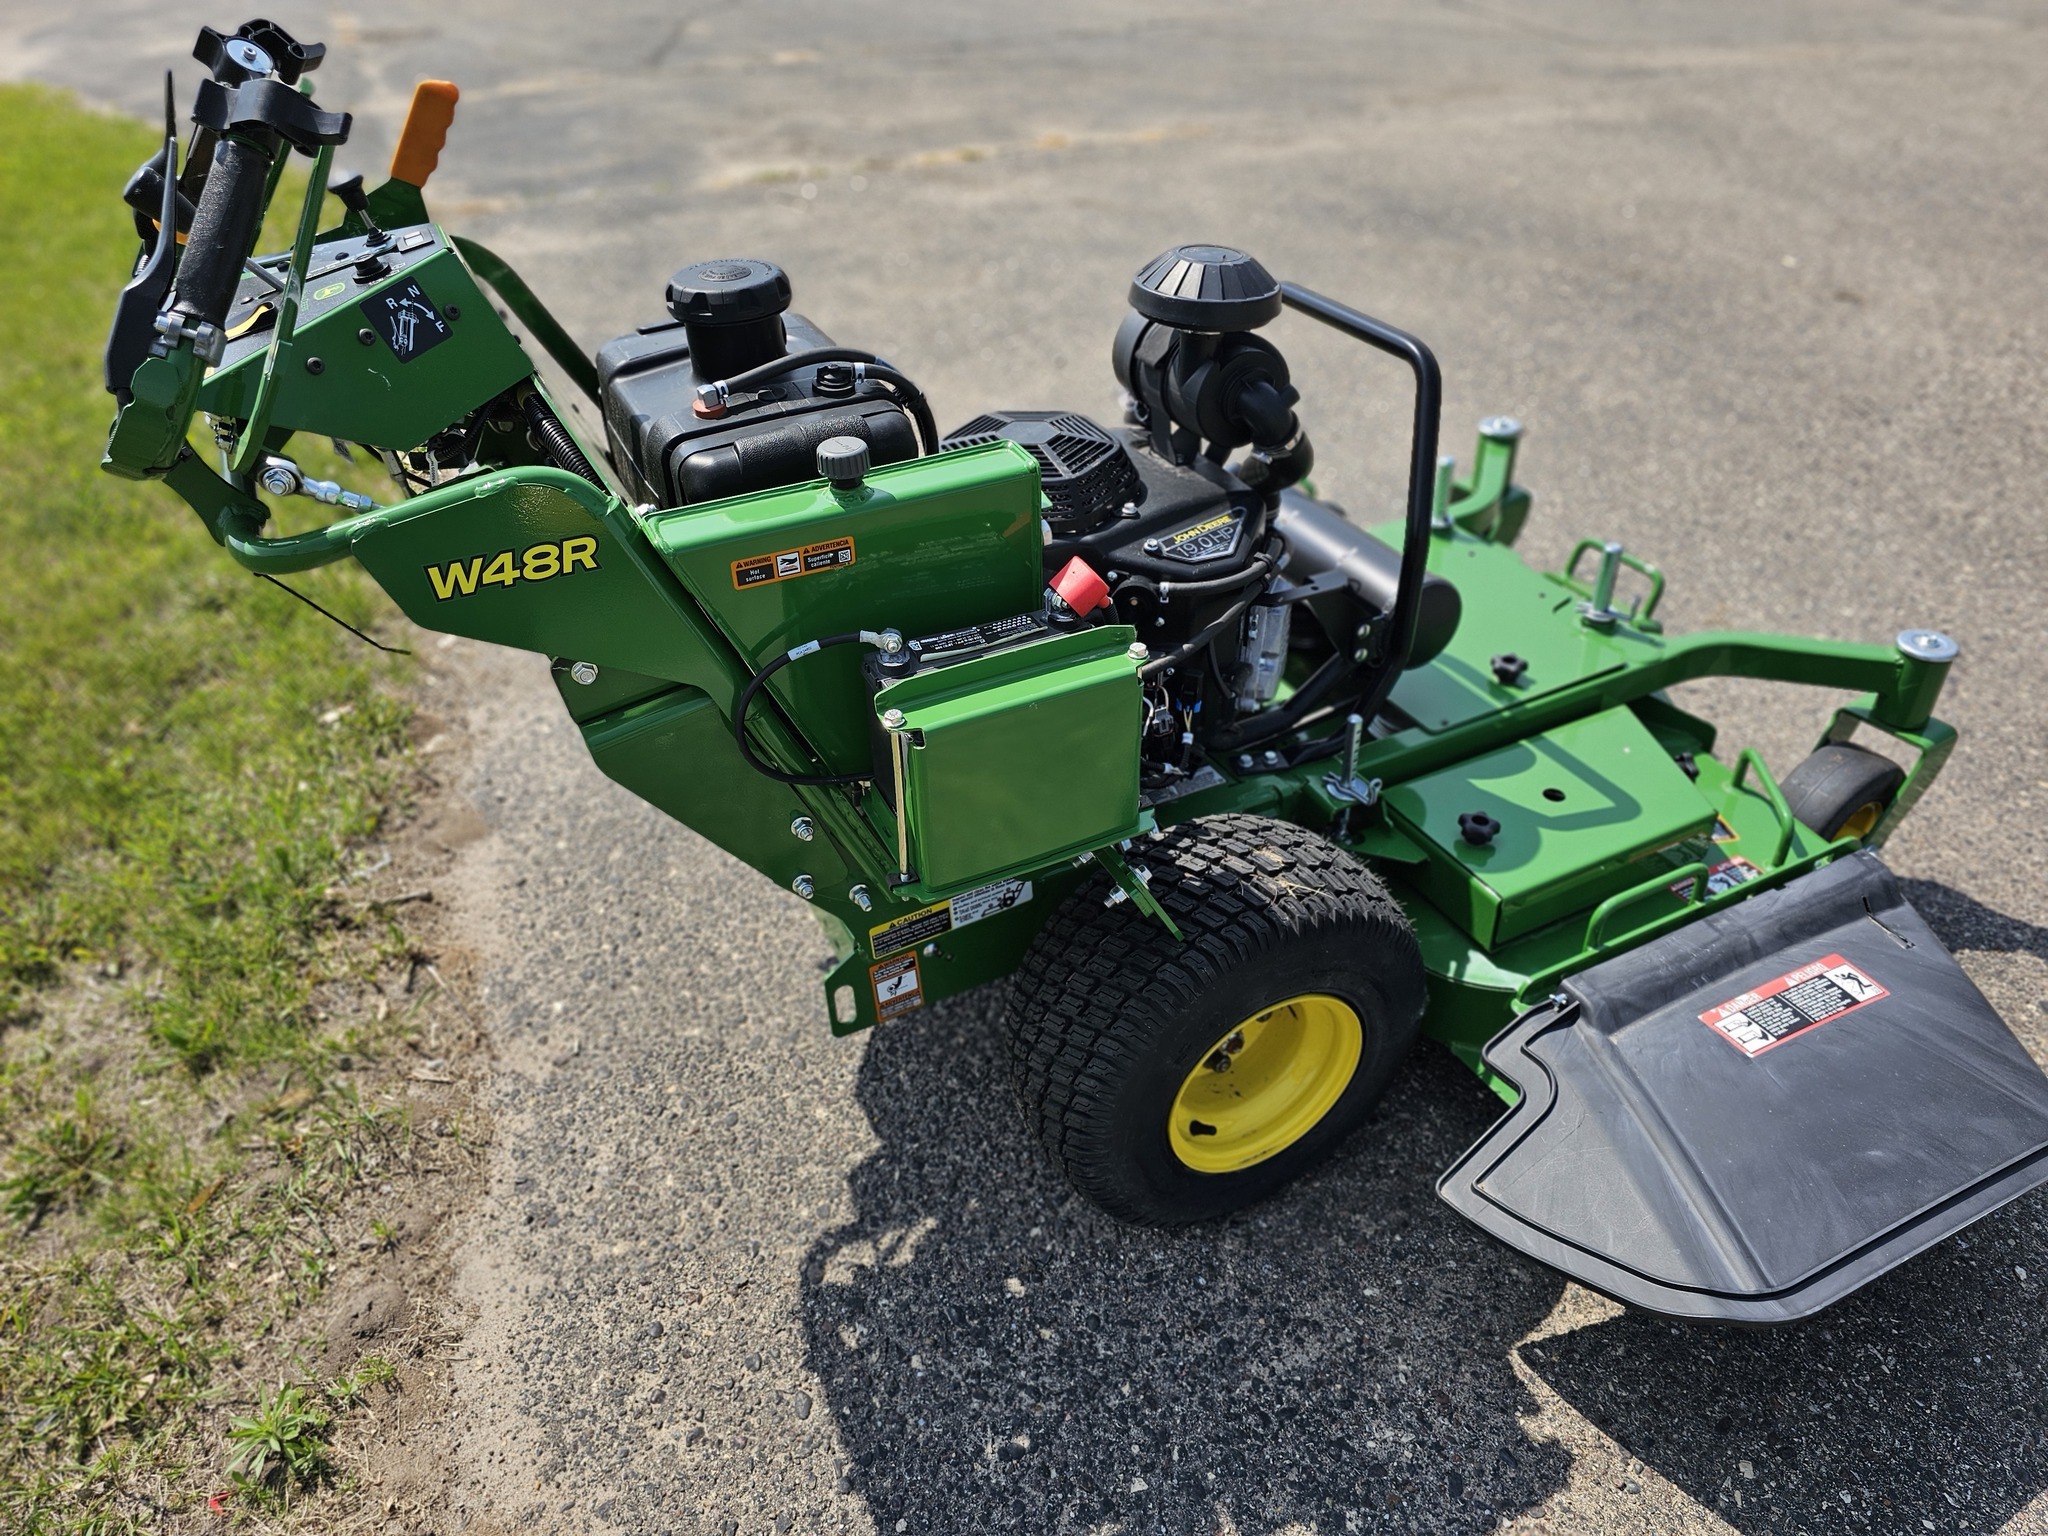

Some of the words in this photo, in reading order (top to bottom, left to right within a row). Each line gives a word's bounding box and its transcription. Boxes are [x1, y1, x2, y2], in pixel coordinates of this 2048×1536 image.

[407, 285, 421, 298] N
[385, 297, 398, 310] R
[435, 320, 445, 333] F
[1173, 526, 1200, 544] JOHN
[1199, 515, 1233, 533] DEERE
[811, 539, 849, 553] ADVERTENCIA
[1177, 536, 1213, 557] 19.0
[1210, 526, 1234, 543] HP
[426, 535, 598, 601] W48R
[743, 556, 772, 568] WARNING
[897, 908, 933, 925] CAUTION
